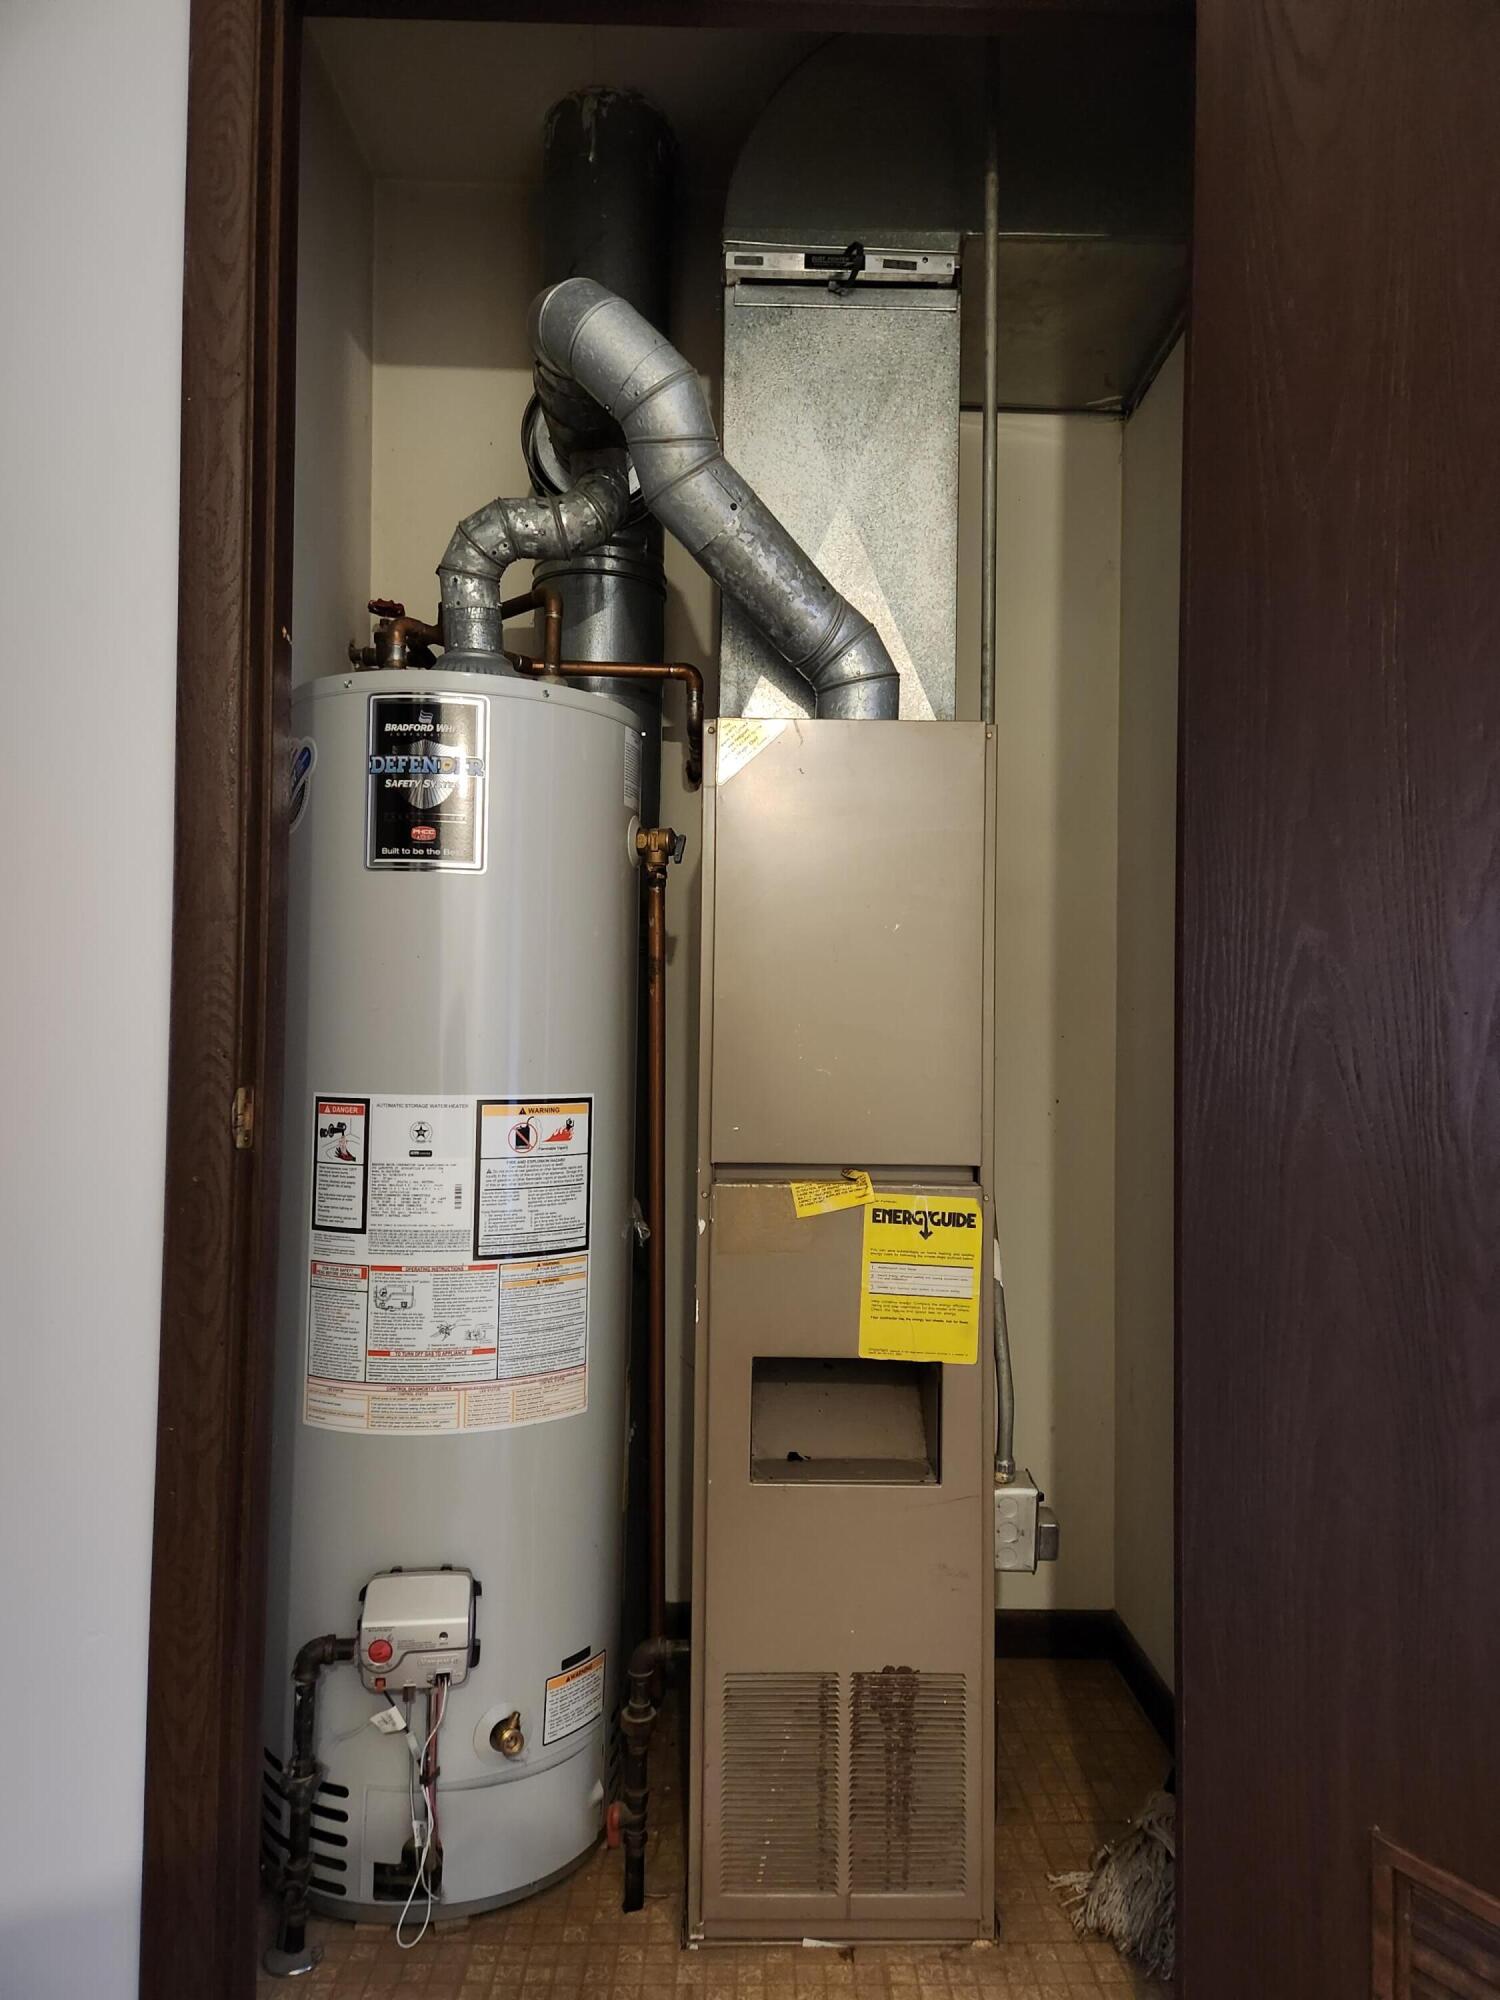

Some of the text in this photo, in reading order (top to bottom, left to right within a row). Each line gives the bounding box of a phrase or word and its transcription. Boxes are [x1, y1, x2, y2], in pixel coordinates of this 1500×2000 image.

[384, 723, 464, 733] BRADFORD WHI
[384, 779, 460, 789] SAFETY SYTE
[381, 847, 400, 855] Built
[412, 847, 424, 855] be
[426, 847, 441, 856] the
[332, 1105, 359, 1114] DANGER
